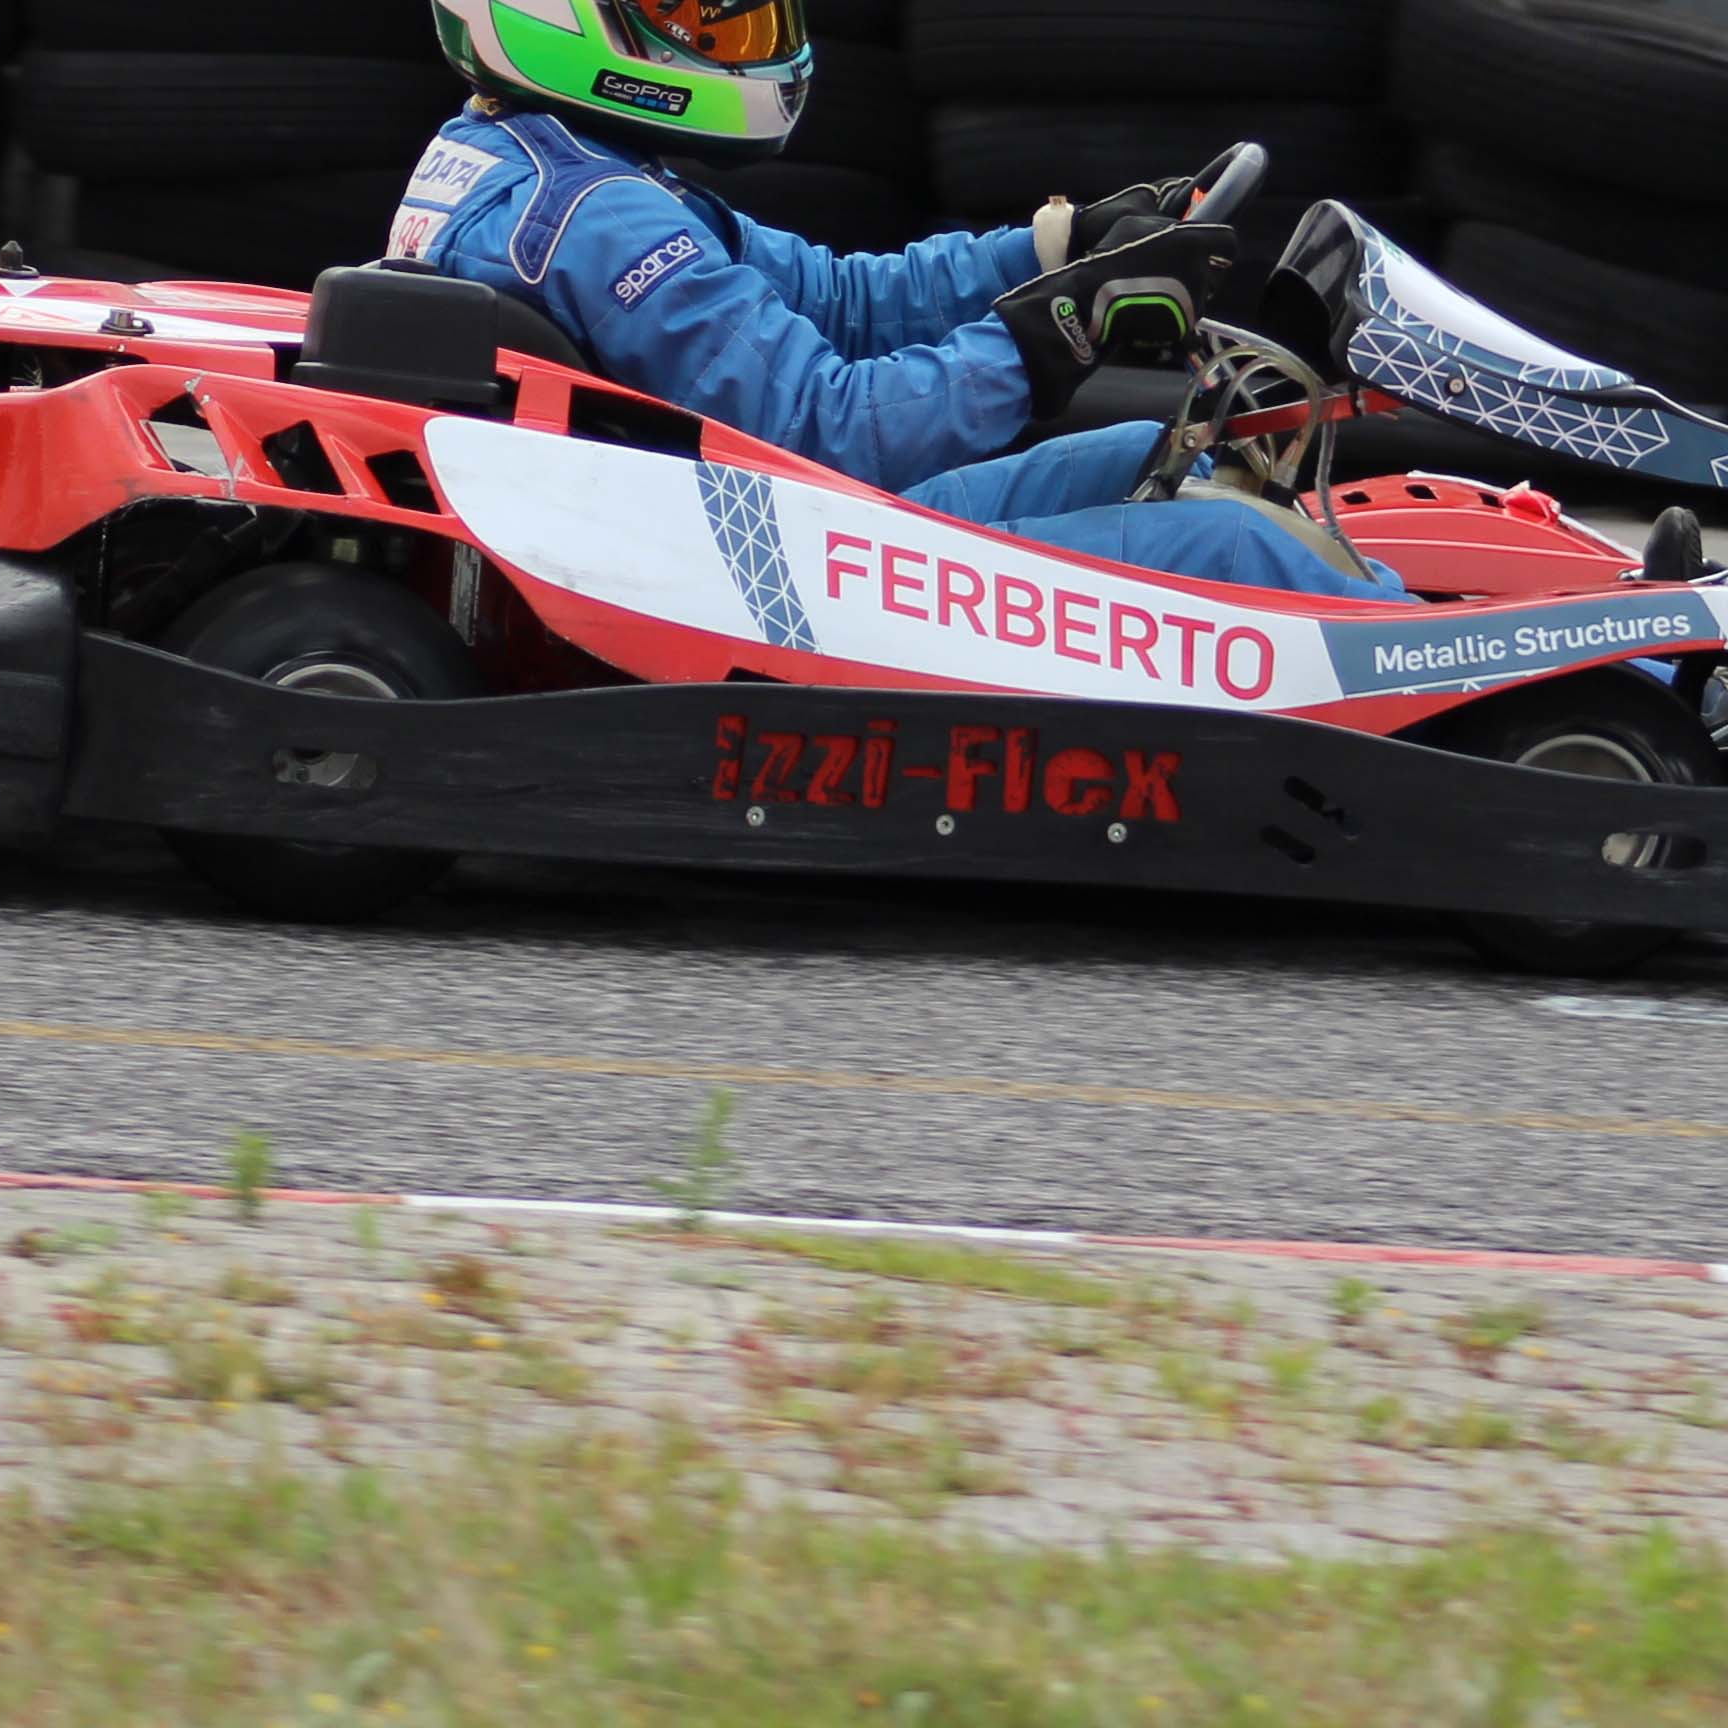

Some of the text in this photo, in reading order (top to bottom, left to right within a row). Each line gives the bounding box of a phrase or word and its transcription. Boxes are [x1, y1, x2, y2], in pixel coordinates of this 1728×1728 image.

[603, 75, 685, 104] GoPro
[615, 235, 697, 302] sparco
[824, 528, 1692, 702] FERBERTO Metallic Structures
